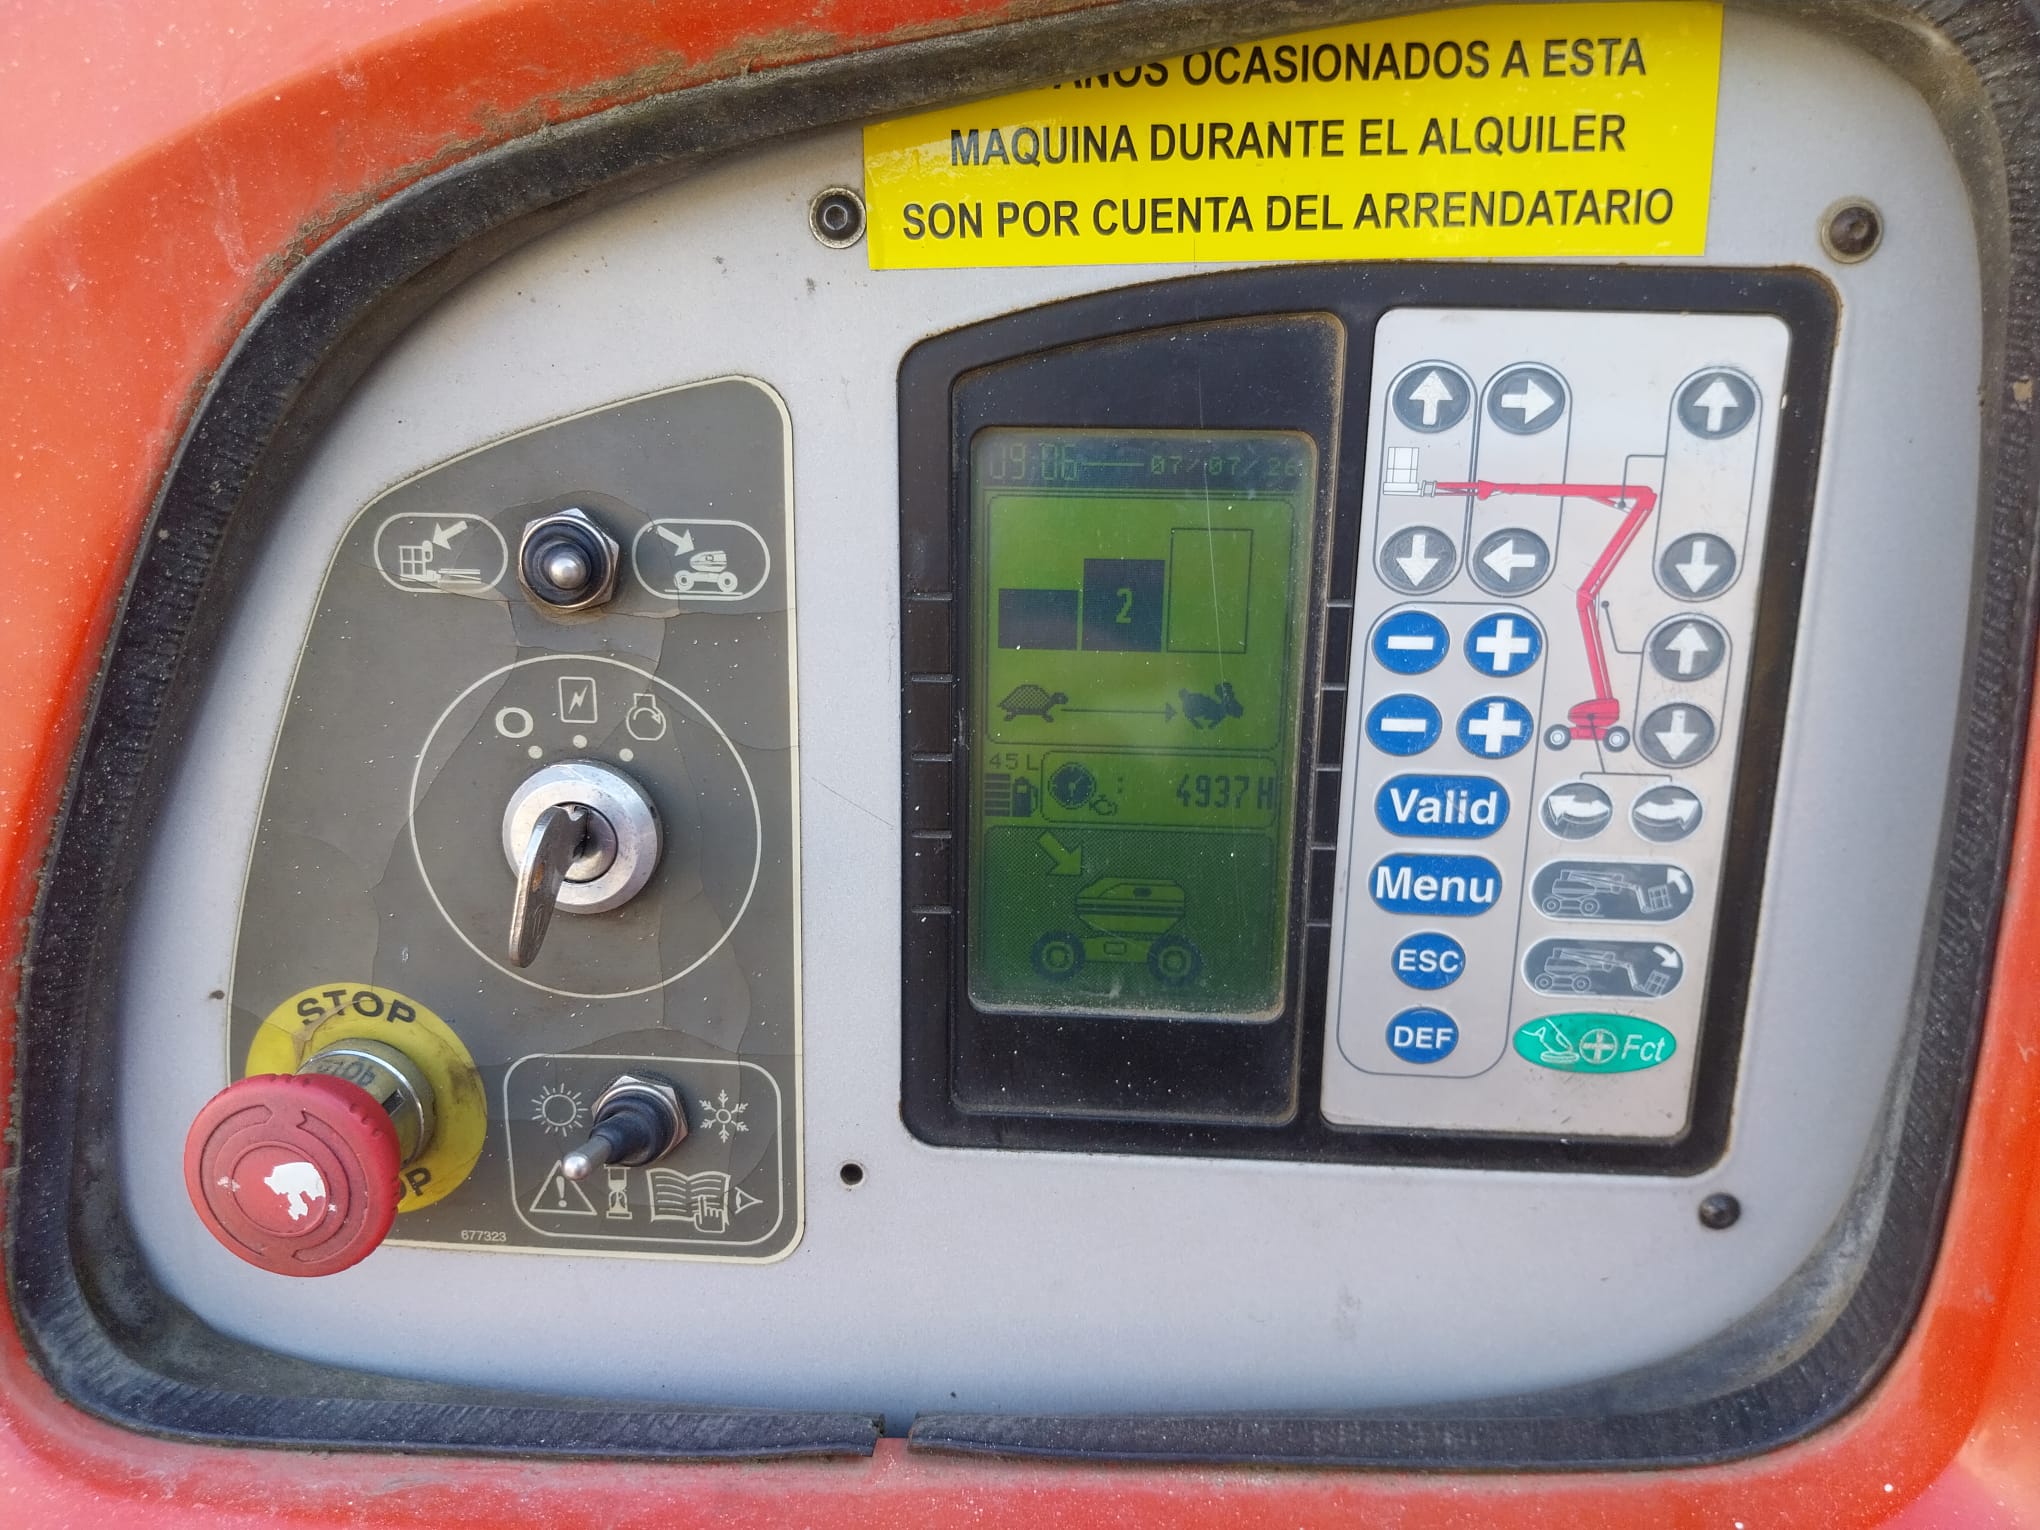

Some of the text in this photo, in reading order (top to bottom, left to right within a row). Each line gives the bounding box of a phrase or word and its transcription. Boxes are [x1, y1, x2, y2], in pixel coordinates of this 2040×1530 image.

[1183, 40, 1490, 86] OCASIONADOS
[1501, 39, 1530, 79] A
[1543, 37, 1647, 78] ESTA
[950, 113, 1627, 168] MAQUINA DURANTE EL ALQUILER
[902, 188, 1675, 240] SON POR CUENTA DEL ARRENDATARIO
[1115, 587, 1134, 625] 2
[1389, 787, 1499, 826] Valid
[1375, 865, 1494, 904] Menu
[1398, 948, 1460, 974] ESC
[296, 988, 417, 1026] STOP
[1393, 1025, 1453, 1050] DEF
[1620, 1033, 1667, 1063] Fct
[460, 1229, 508, 1243] 677323
